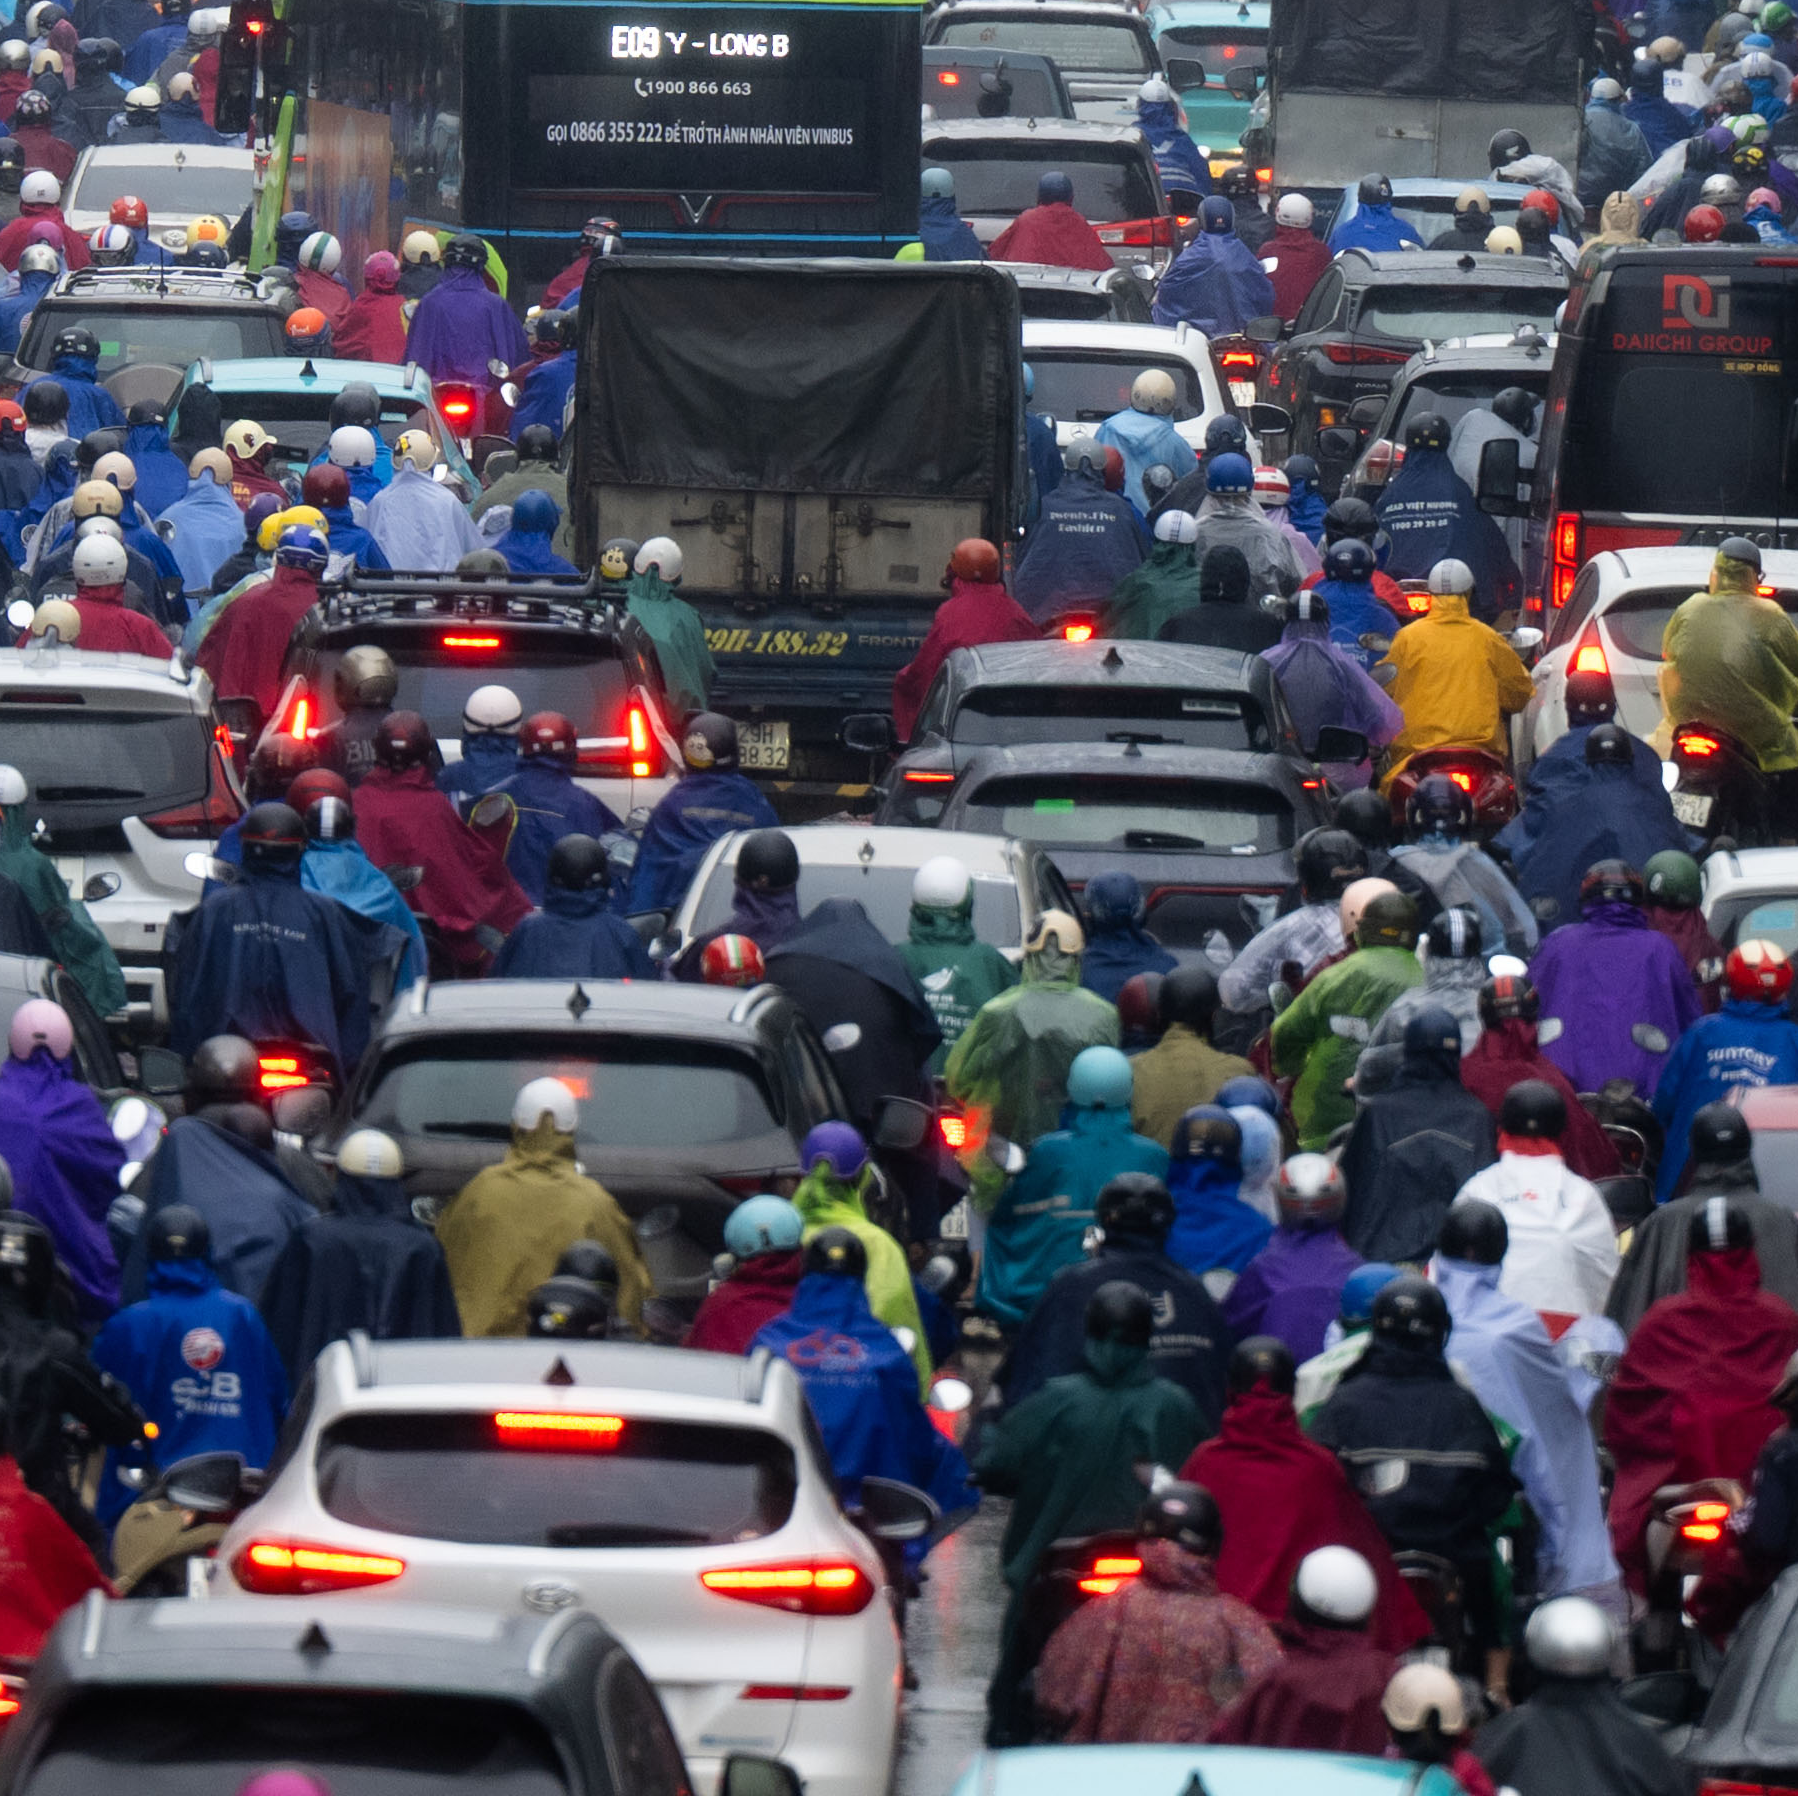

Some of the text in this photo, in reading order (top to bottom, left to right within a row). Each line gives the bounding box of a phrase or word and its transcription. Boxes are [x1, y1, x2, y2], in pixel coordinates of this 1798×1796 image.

[611, 26, 660, 58] E09
[709, 34, 767, 57] LONG
[646, 80, 752, 96] 1900 866 663
[547, 124, 567, 146] GỌI
[570, 121, 605, 142] 0866
[608, 121, 634, 142] 355
[637, 122, 662, 142] 222
[750, 124, 783, 145] NHÂN
[784, 124, 810, 145] VIÊN
[811, 128, 853, 145] VINBUS
[1612, 332, 1773, 354] DAIICHI GROUP
